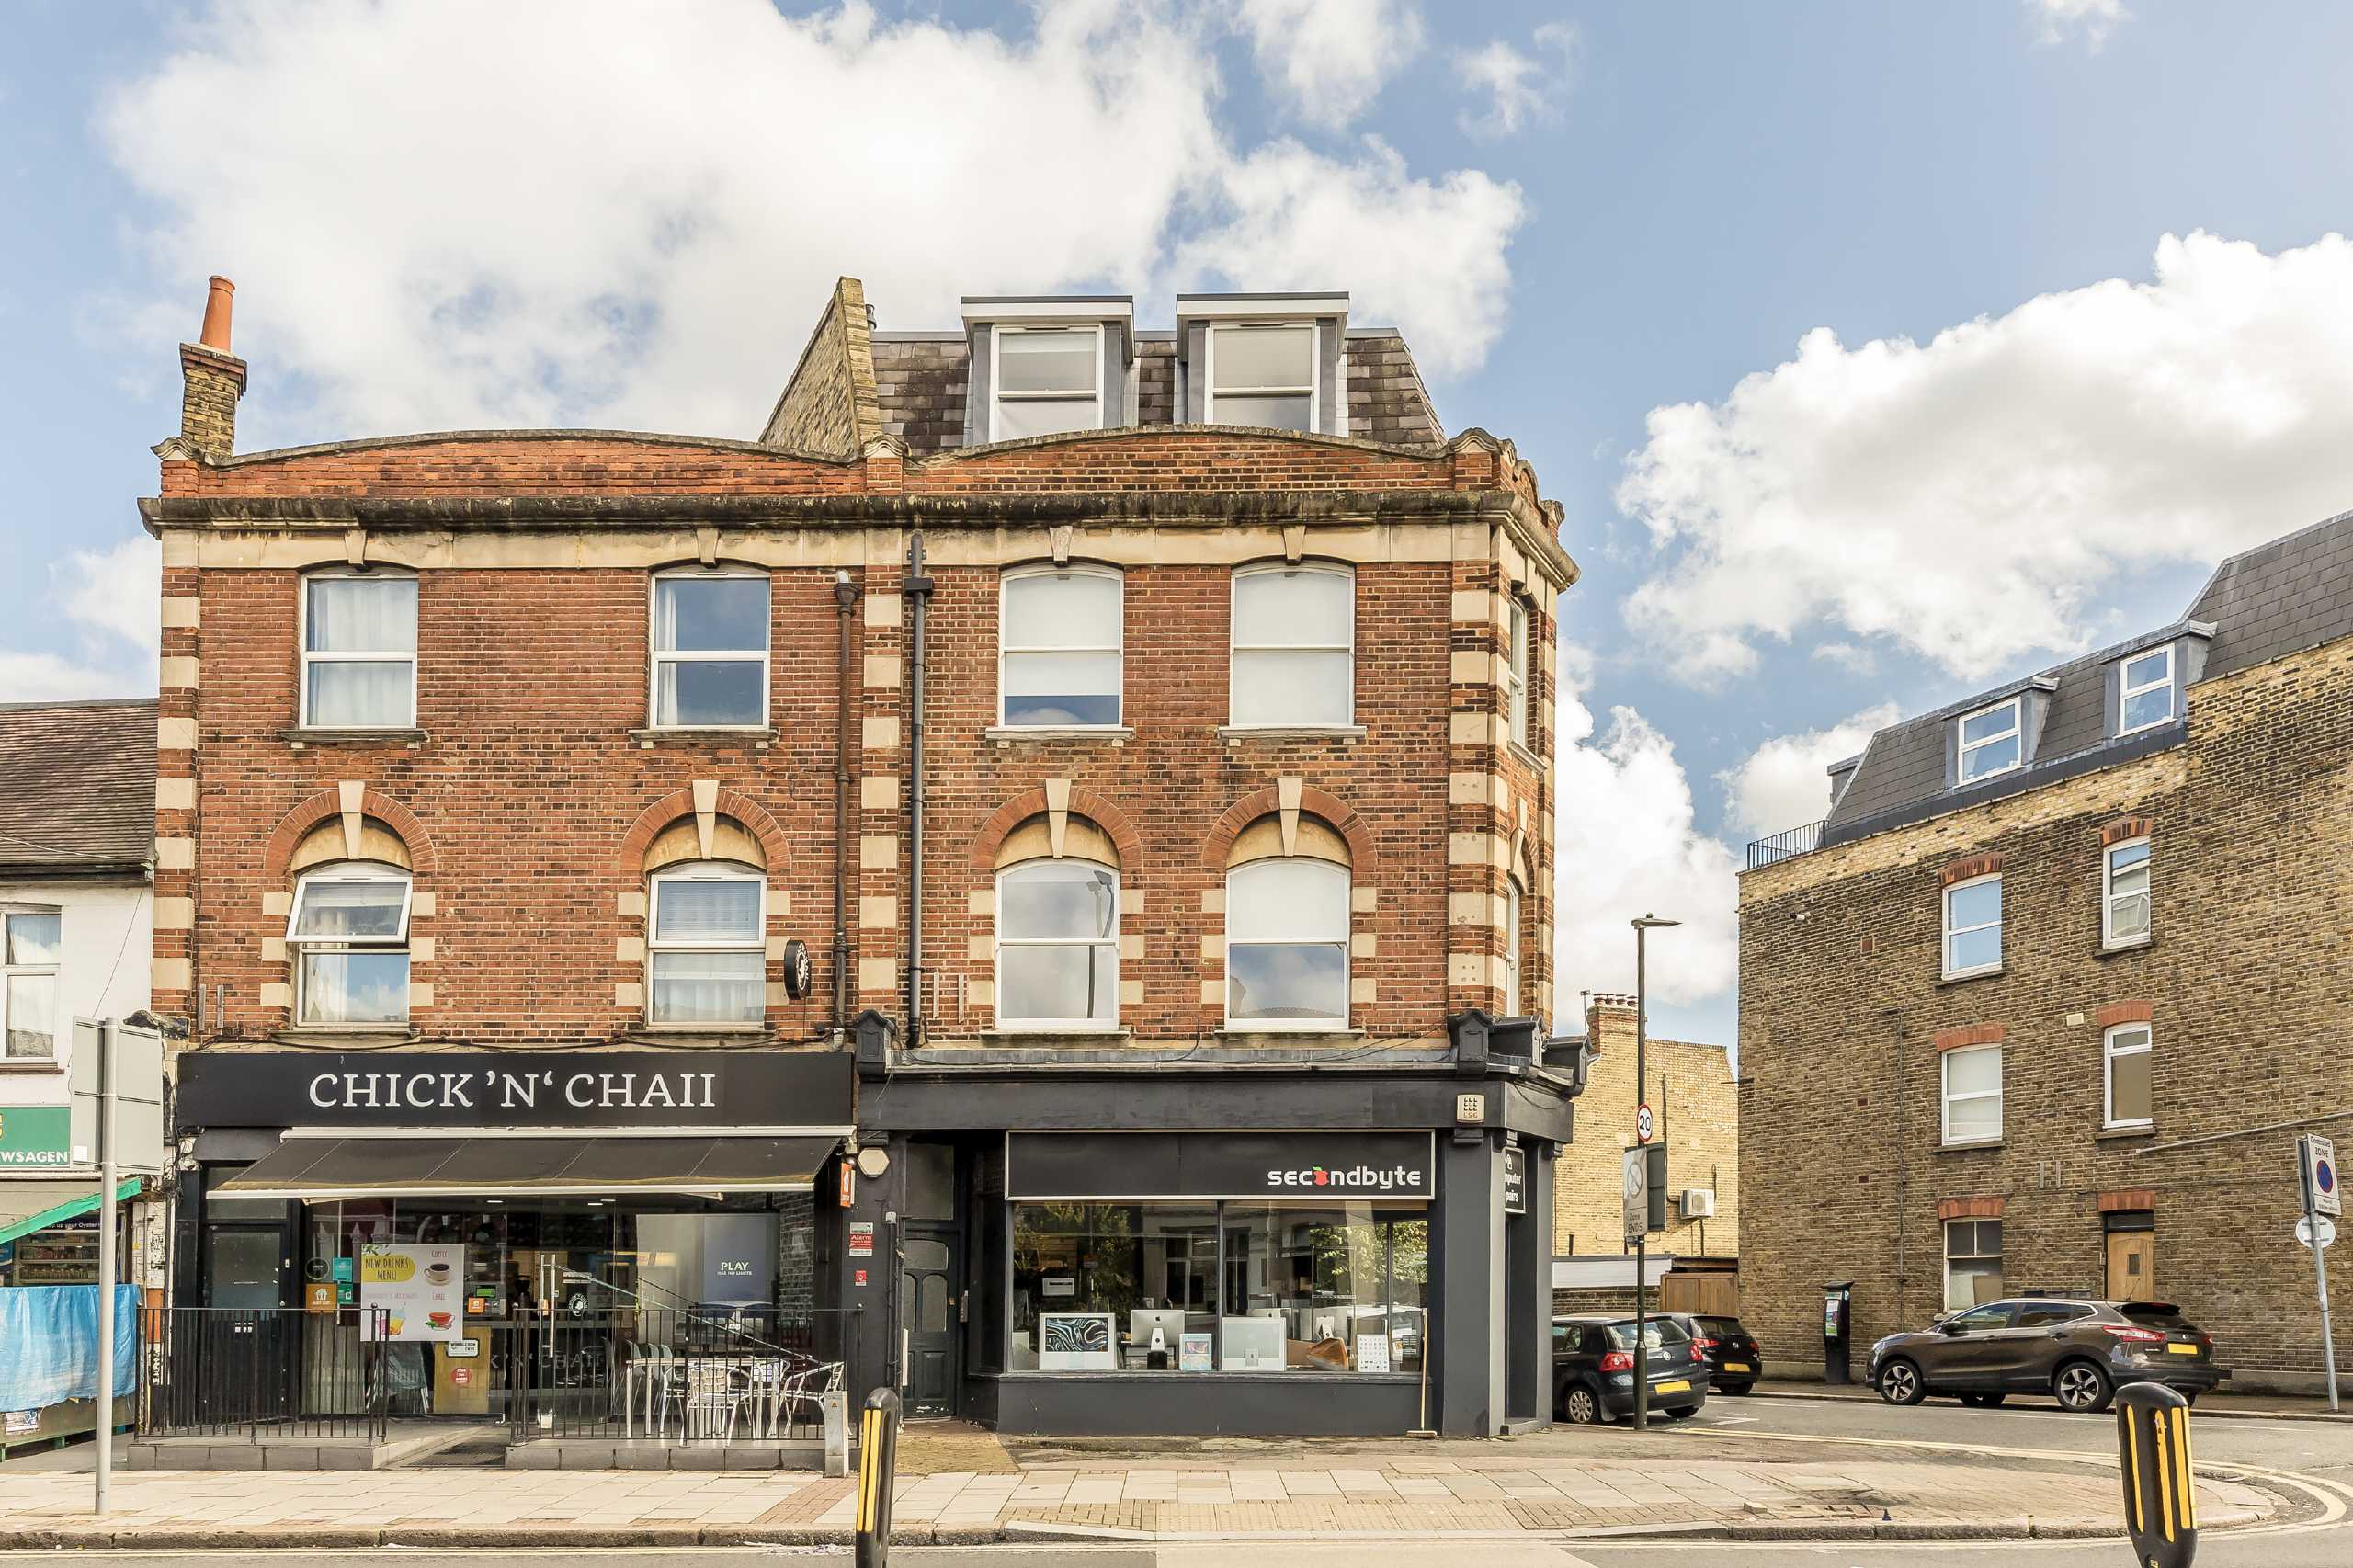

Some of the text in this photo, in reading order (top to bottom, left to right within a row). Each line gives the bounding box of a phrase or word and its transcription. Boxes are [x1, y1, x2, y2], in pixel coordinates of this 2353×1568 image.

[309, 1074, 473, 1107] CHICK
[565, 1074, 716, 1107] CHAII
[1639, 1115, 1652, 1131] 20
[0, 1151, 69, 1163] WSAGEN
[2314, 1147, 2328, 1158] ZONE
[1628, 1221, 1643, 1233] ENDS
[365, 1256, 409, 1268] NEW DRINKS
[721, 1262, 749, 1270] PLAY
[377, 1270, 397, 1280] MENU
